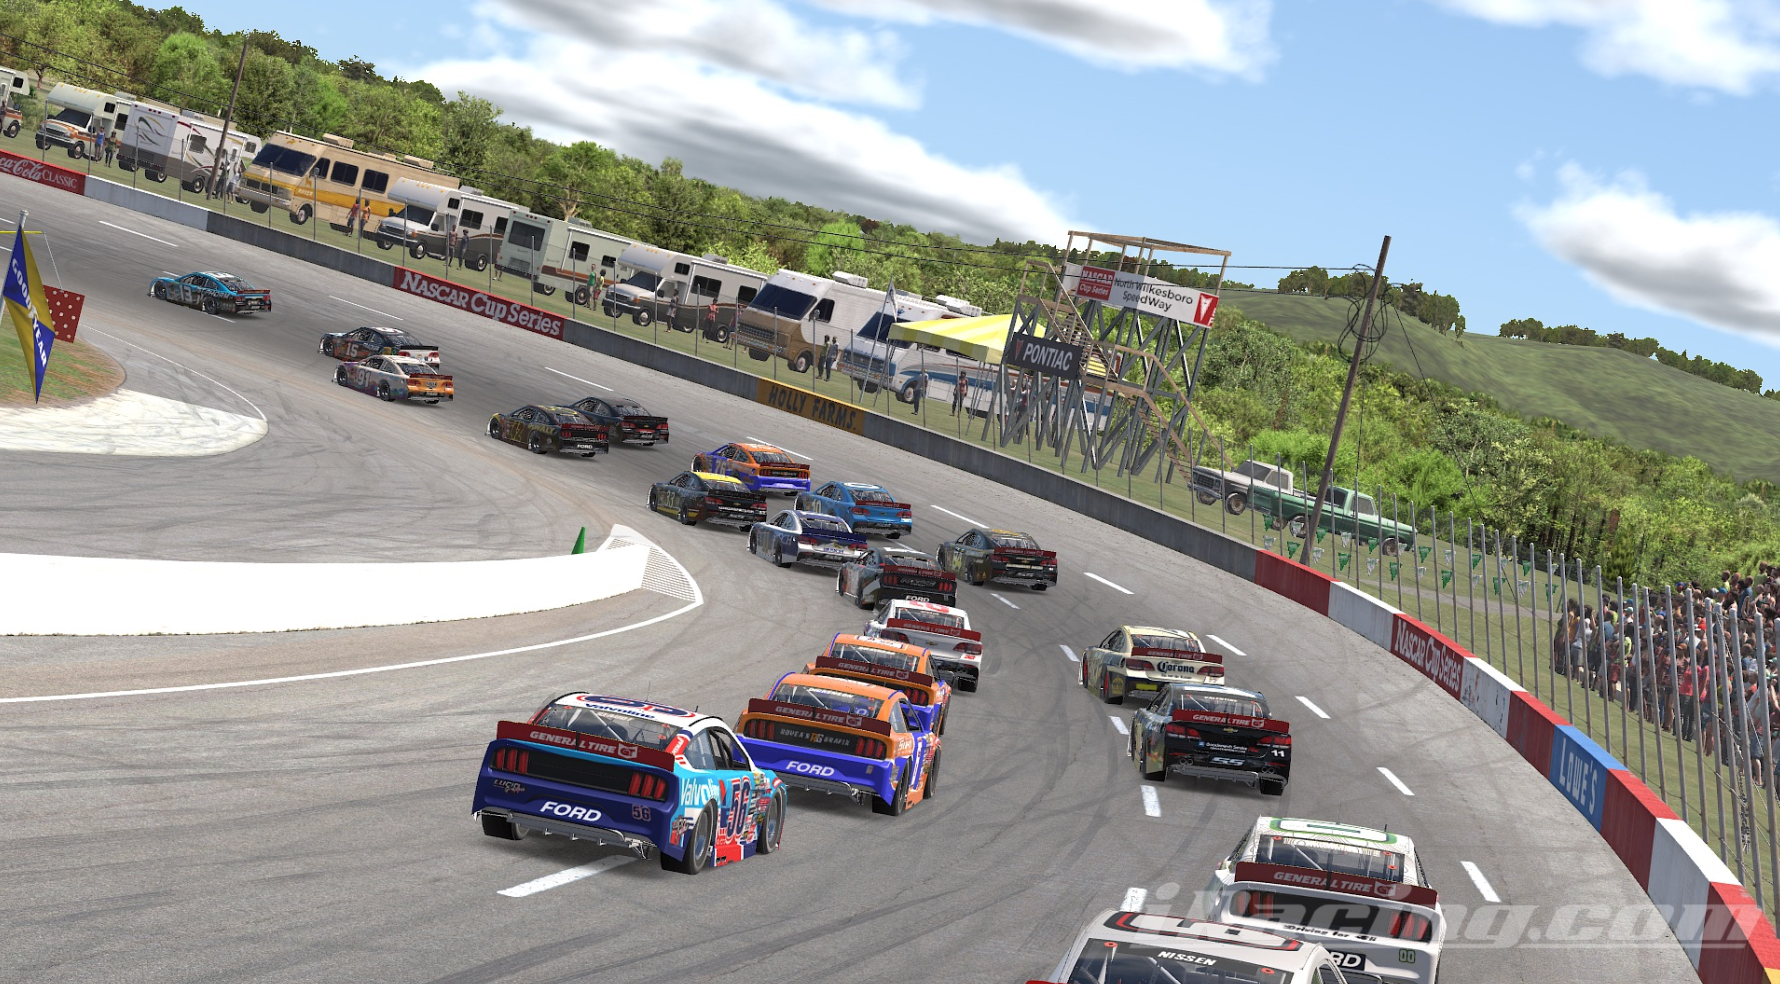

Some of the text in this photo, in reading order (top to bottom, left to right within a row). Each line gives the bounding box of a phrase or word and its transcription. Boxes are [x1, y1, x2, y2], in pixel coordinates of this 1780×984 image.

[42, 169, 78, 189] CLASSIC
[1081, 269, 1114, 285] NASCAR
[1080, 283, 1092, 293] Cup
[1114, 277, 1194, 305] North Wilkesboro
[400, 271, 562, 336] NASCAR Cup Series
[1122, 290, 1173, 313] SpeedWay
[11, 257, 48, 368] GOODYEAR
[346, 342, 359, 357] 15
[1022, 342, 1074, 371] PONTIAC
[357, 368, 372, 388] 91
[768, 385, 807, 414] HOLLY
[906, 594, 930, 603] FORD
[1394, 618, 1426, 668] NASCAR
[1425, 636, 1441, 682] Cup
[1438, 644, 1462, 693] Series
[838, 662, 896, 677] GENERAL TIRE
[1157, 660, 1195, 674] Corona
[775, 705, 821, 719] GENERAL
[822, 713, 845, 723] TIRE
[1192, 714, 1250, 726] GENERAL TIRE
[529, 730, 587, 749] GENERAL
[587, 740, 617, 754] TIRE
[1271, 749, 1285, 757] 11
[786, 760, 835, 777] FORD
[540, 801, 602, 822] FORD
[631, 803, 652, 821] 56
[727, 776, 752, 844] 56
[1273, 871, 1338, 889] GENERAL
[1340, 881, 1373, 893] TIRE
[1157, 950, 1217, 966] NISSEN
[1329, 952, 1362, 968] RD
[1399, 948, 1416, 963] 00
